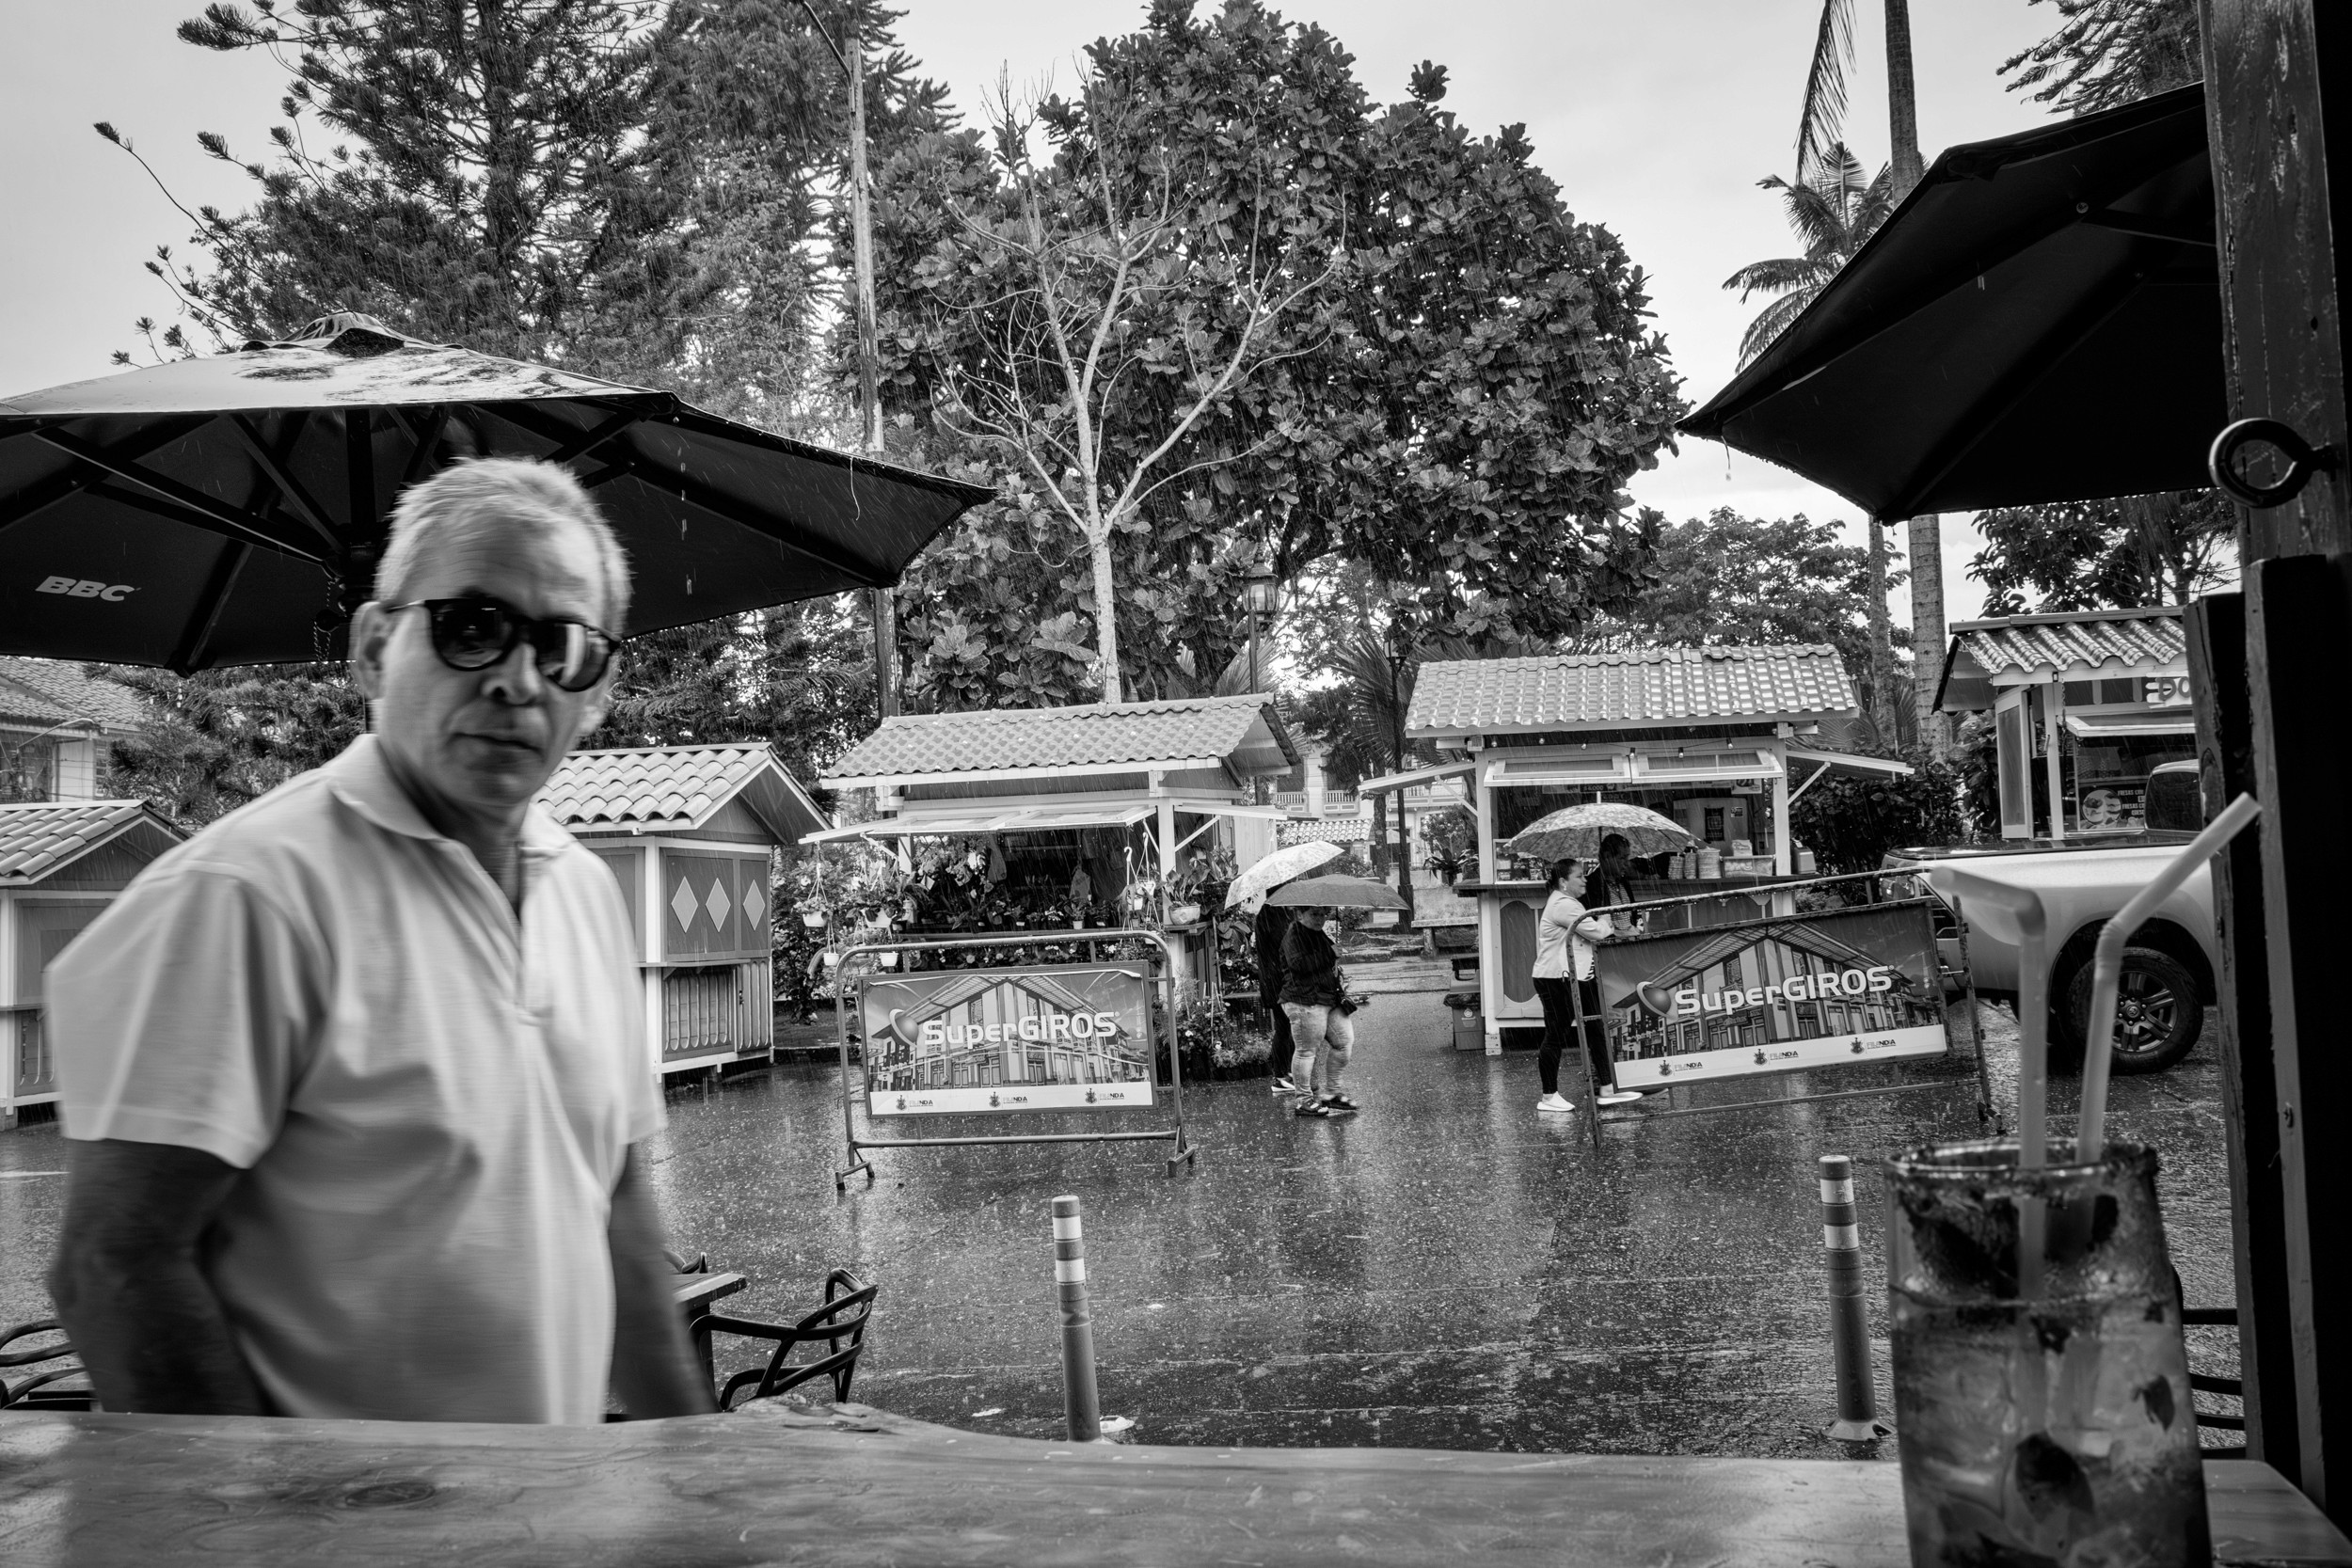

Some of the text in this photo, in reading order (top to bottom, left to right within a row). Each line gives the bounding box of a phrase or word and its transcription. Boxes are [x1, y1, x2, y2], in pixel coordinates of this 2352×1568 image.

[35, 576, 135, 601] BBC
[1675, 966, 1892, 1015] SuperGIROS
[922, 1012, 1117, 1050] SuperGIROS
